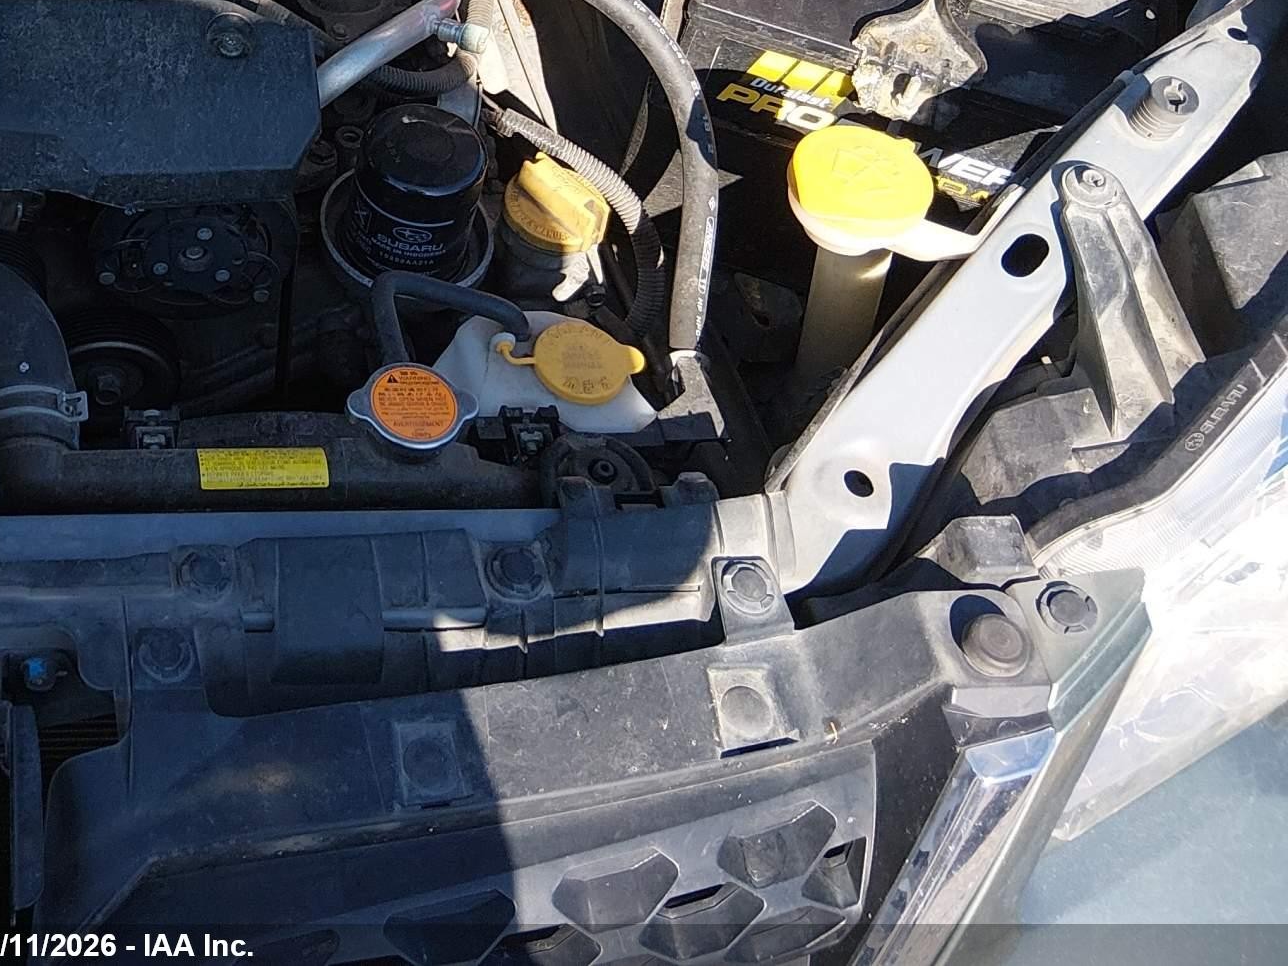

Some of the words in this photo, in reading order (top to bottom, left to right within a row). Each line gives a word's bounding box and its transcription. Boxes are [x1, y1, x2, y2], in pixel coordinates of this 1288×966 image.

[716, 82, 836, 131] PRO
[750, 77, 832, 108] Duralast
[376, 233, 444, 252] SUBARU
[1199, 383, 1249, 435] SUBARU
